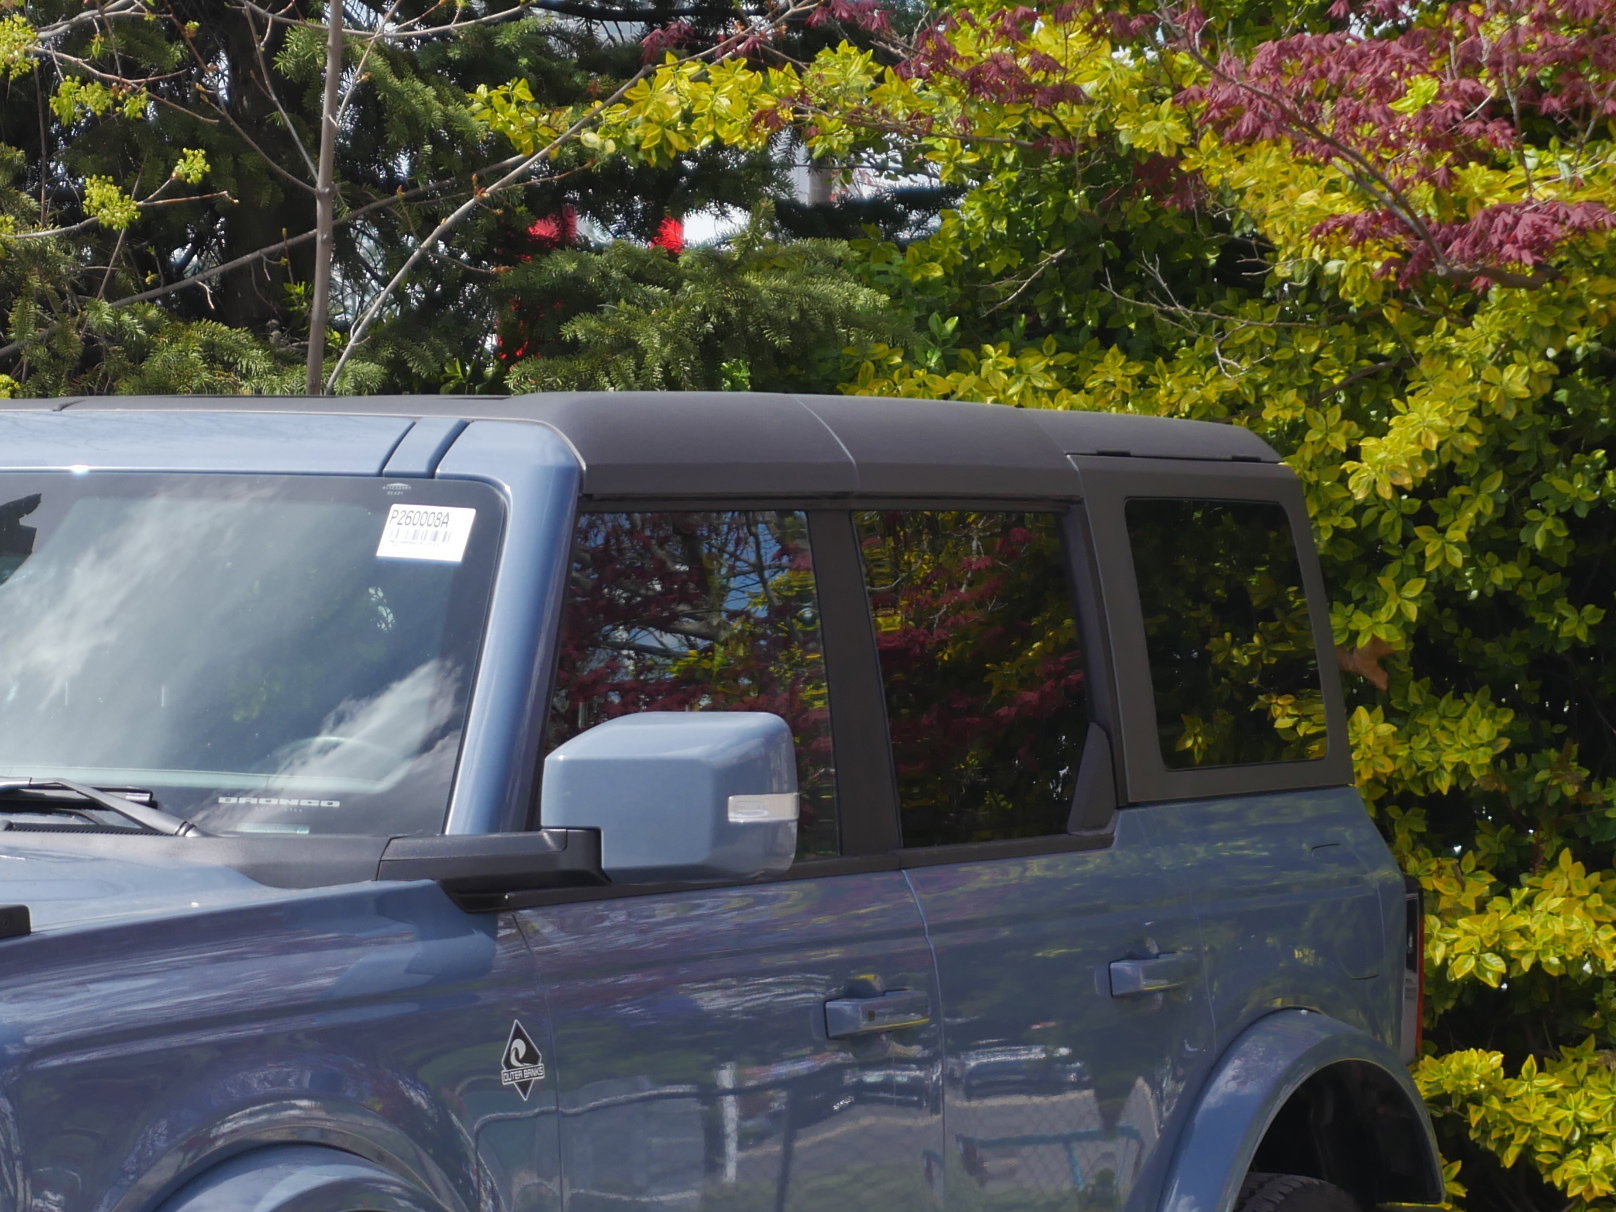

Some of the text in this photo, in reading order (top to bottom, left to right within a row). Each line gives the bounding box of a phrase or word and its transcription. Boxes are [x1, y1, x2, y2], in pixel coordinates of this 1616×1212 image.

[389, 509, 450, 528] P260008A
[504, 1066, 544, 1082] OUTER BANKS
